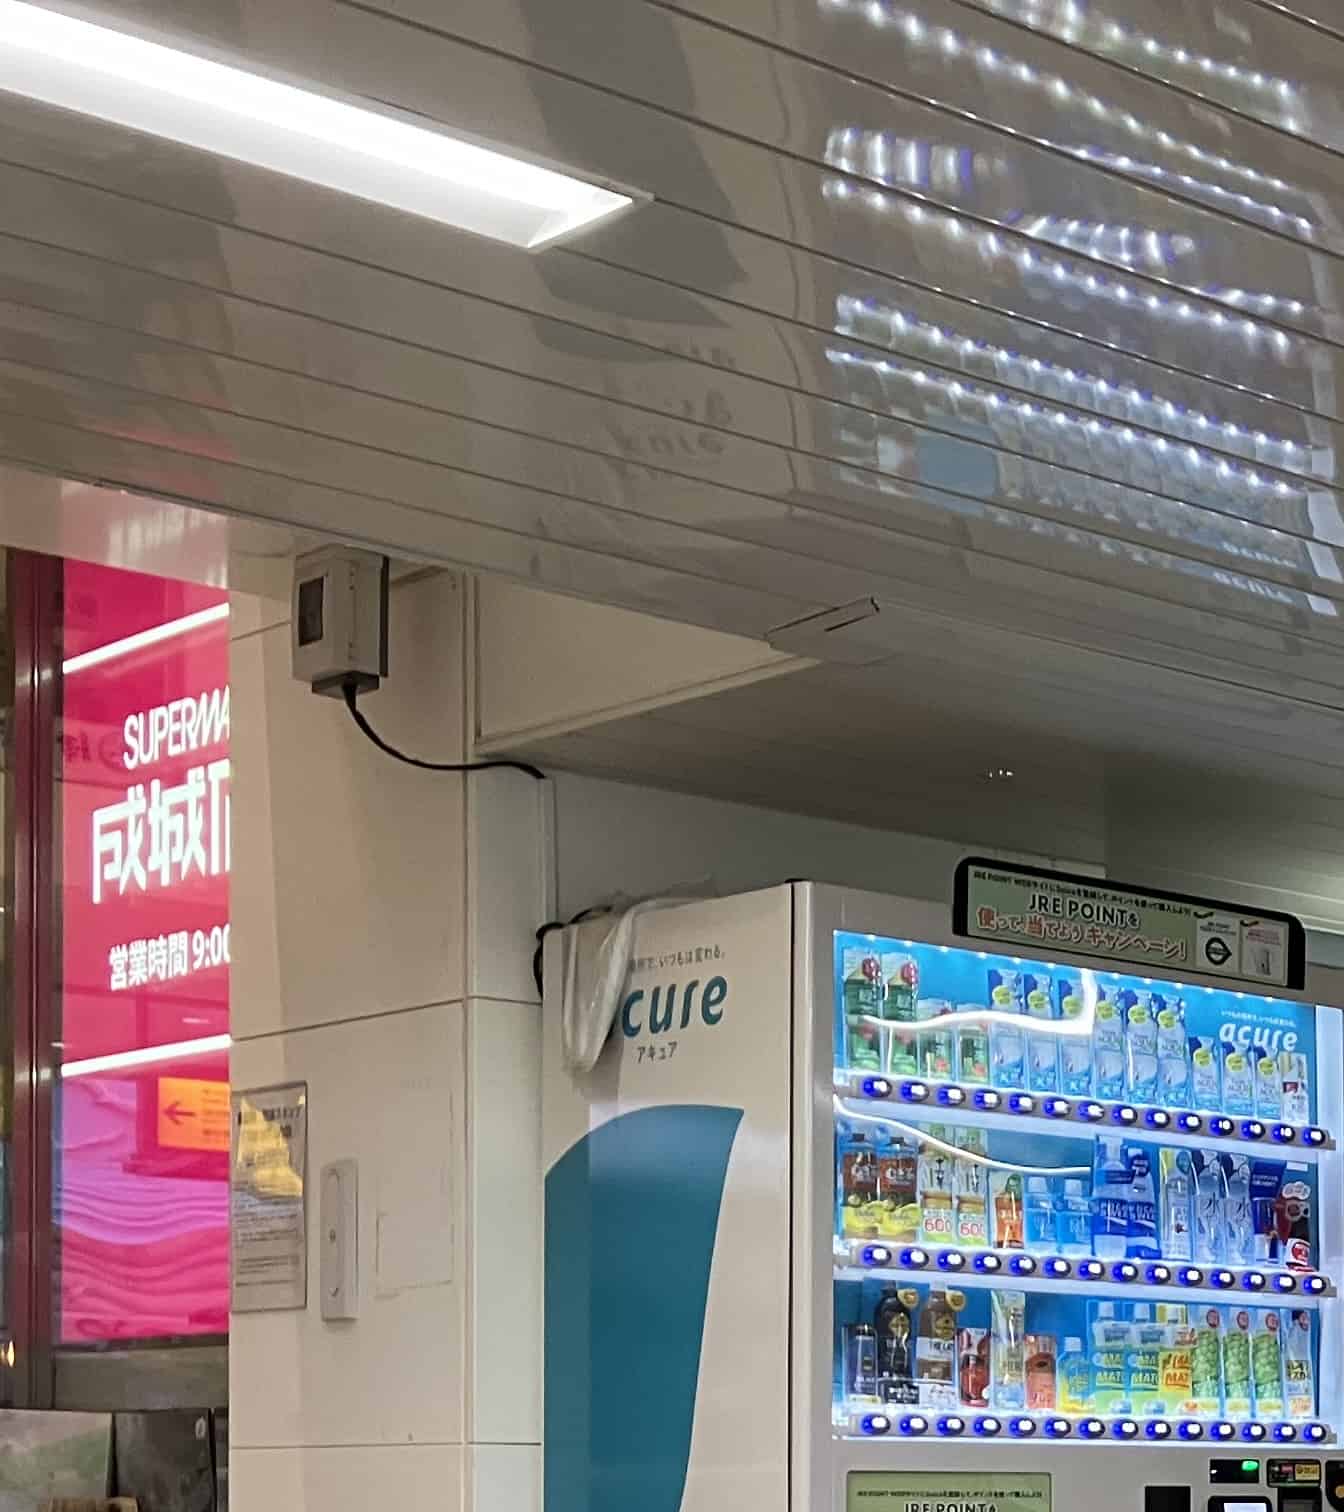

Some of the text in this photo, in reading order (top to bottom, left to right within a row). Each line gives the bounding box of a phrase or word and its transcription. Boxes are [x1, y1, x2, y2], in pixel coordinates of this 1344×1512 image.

[1028, 893, 1063, 914] JRE
[109, 931, 189, 993] 営業時間
[1219, 1022, 1299, 1052] acure
